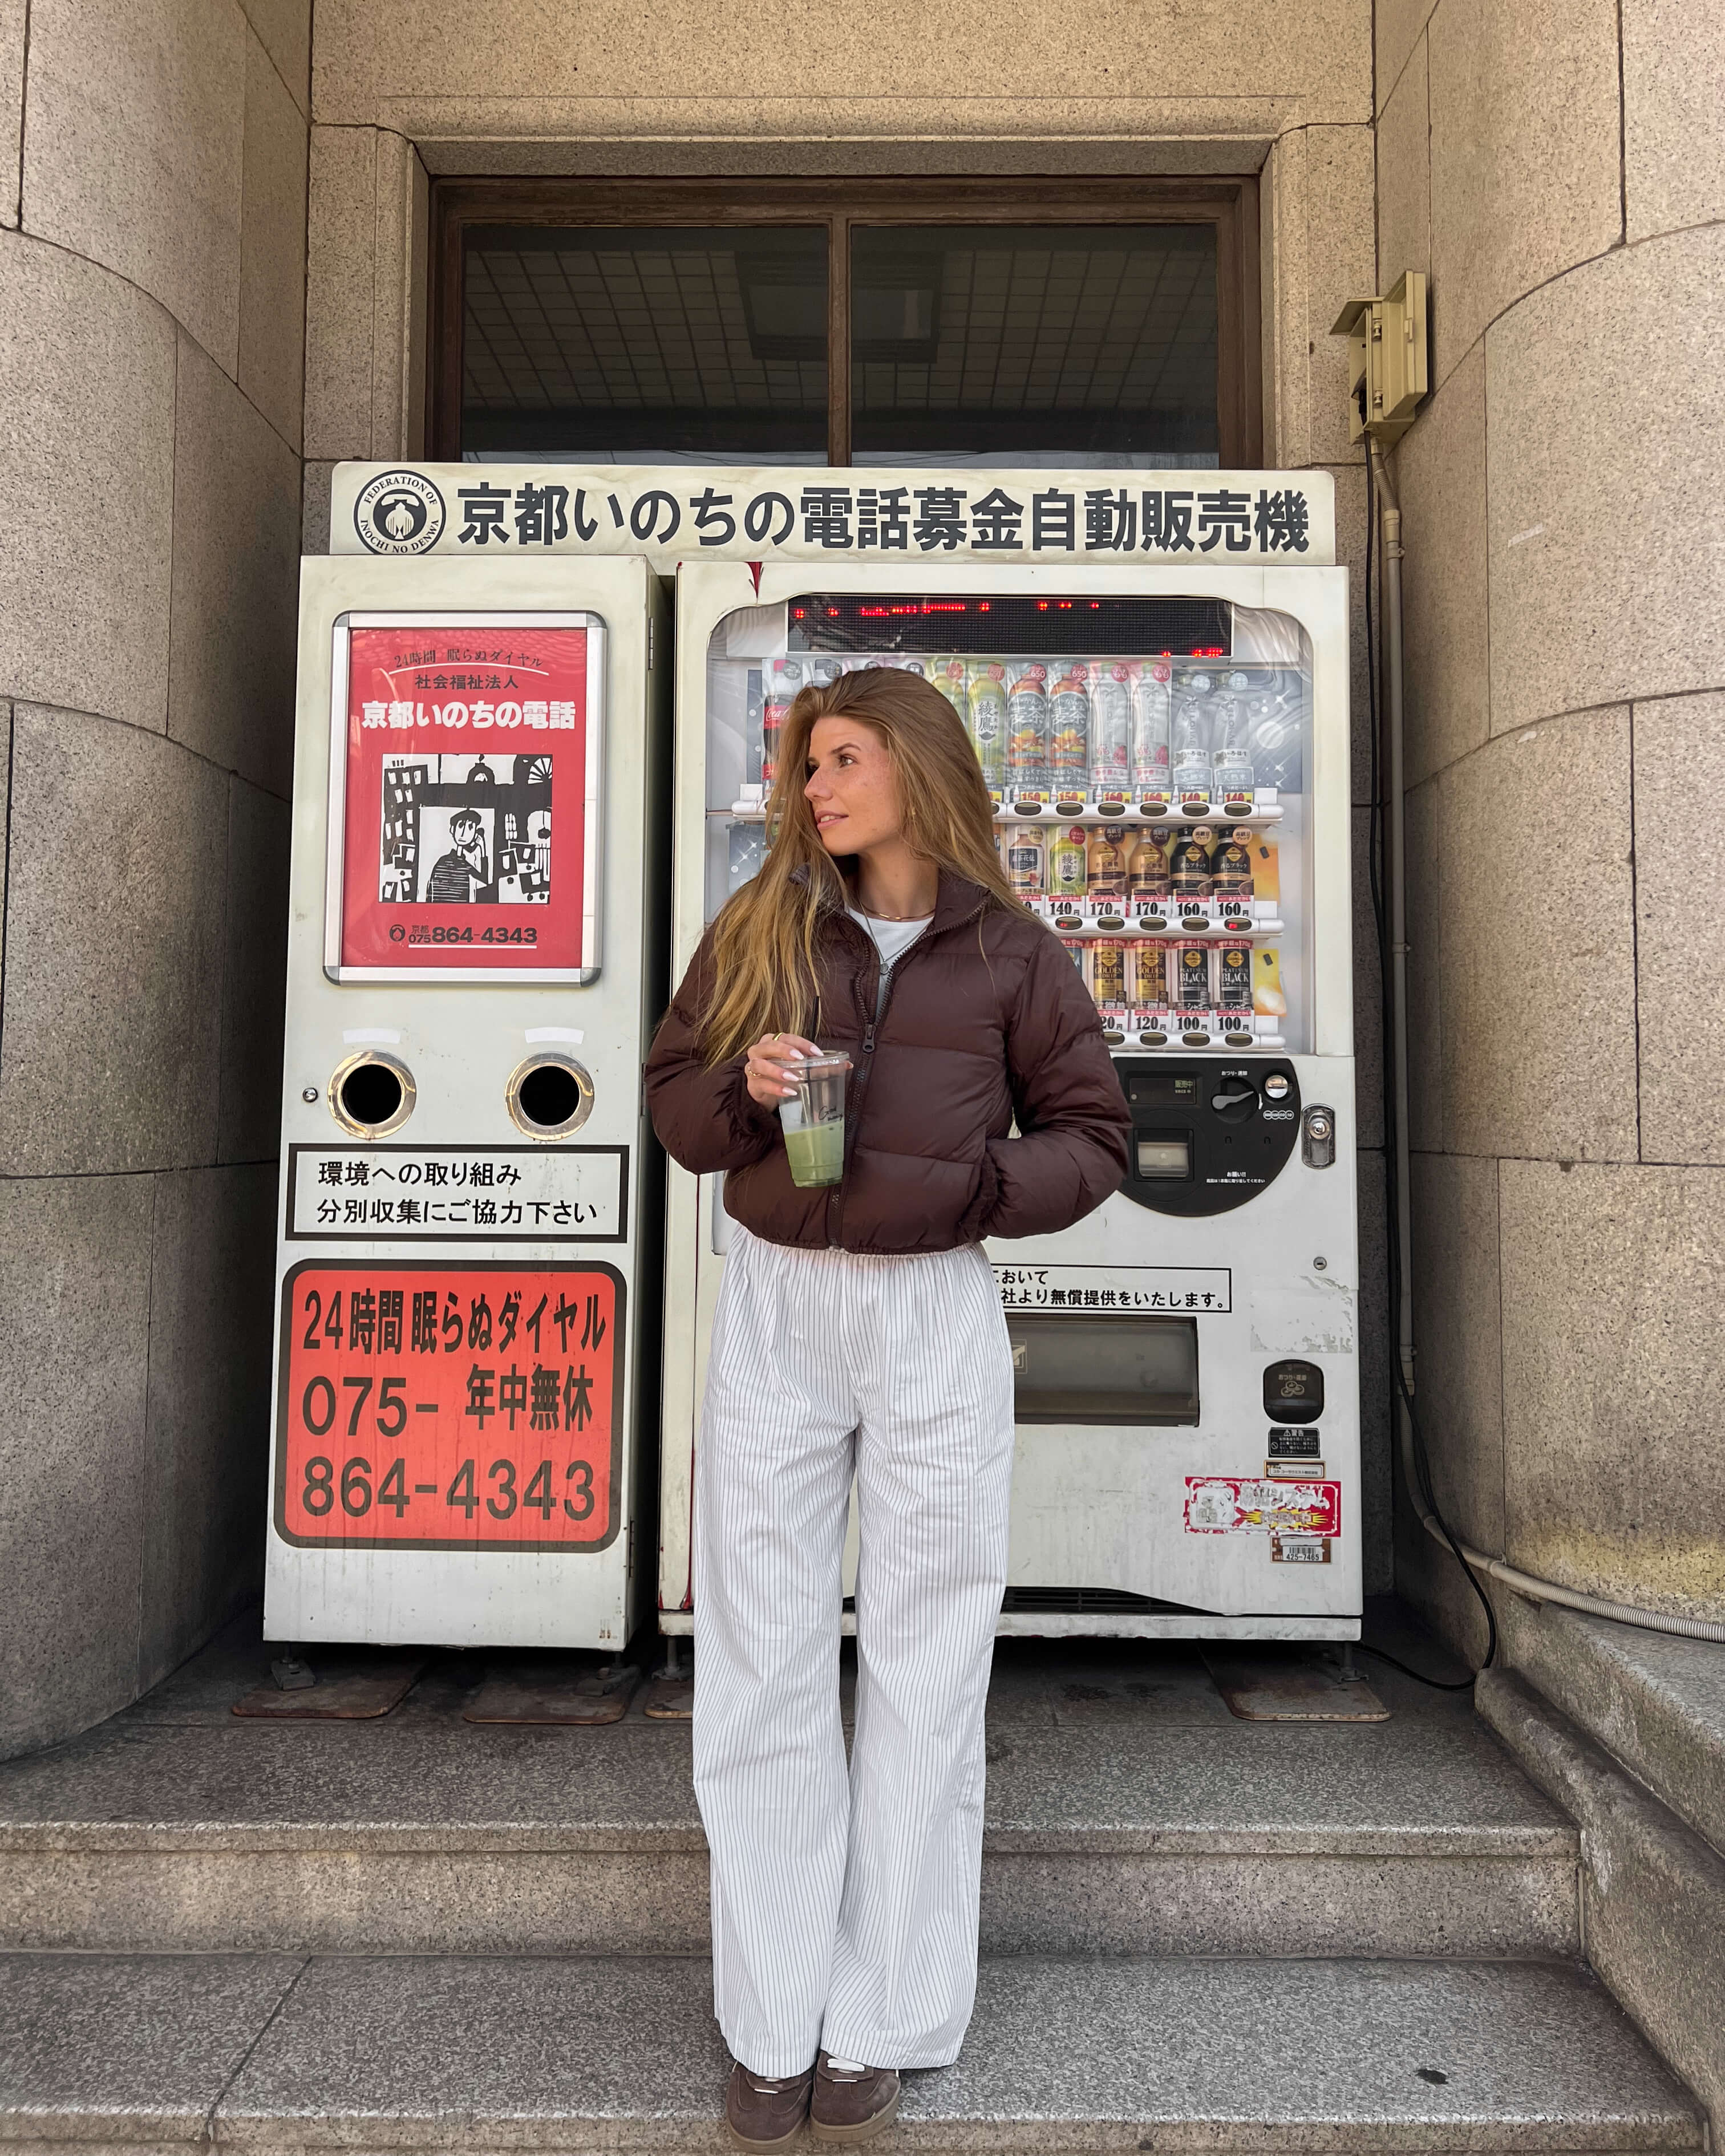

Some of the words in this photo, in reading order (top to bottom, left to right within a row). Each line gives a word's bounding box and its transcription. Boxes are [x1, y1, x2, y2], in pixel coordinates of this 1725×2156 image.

[364, 476, 427, 504] FEDERATION
[426, 492, 438, 505] OF
[457, 482, 1309, 553] 京都いのちの電話募金自動販売機
[361, 520, 389, 550] INOCHI
[411, 520, 439, 550] DENWA
[394, 650, 436, 667] 24時間
[447, 649, 543, 667] 眠らぬダイヤル
[415, 674, 519, 690] 社会福祉法人
[362, 701, 576, 730] 京都いのちの電話
[408, 934, 431, 943] 075
[432, 927, 537, 943] 864-4343
[411, 925, 430, 935] 京都
[1180, 972, 1207, 982] BLACK
[1222, 972, 1249, 982] BLACK
[1101, 1016, 1122, 1030] 20円
[318, 1162, 522, 1186] 環境への取り組み
[317, 1198, 597, 1225] 分別収集にご協力下さい
[1001, 1288, 1223, 1308] 社より無償提供をいたします。
[465, 1363, 593, 1432] 年中無休
[302, 1456, 594, 1521] 864-4343
